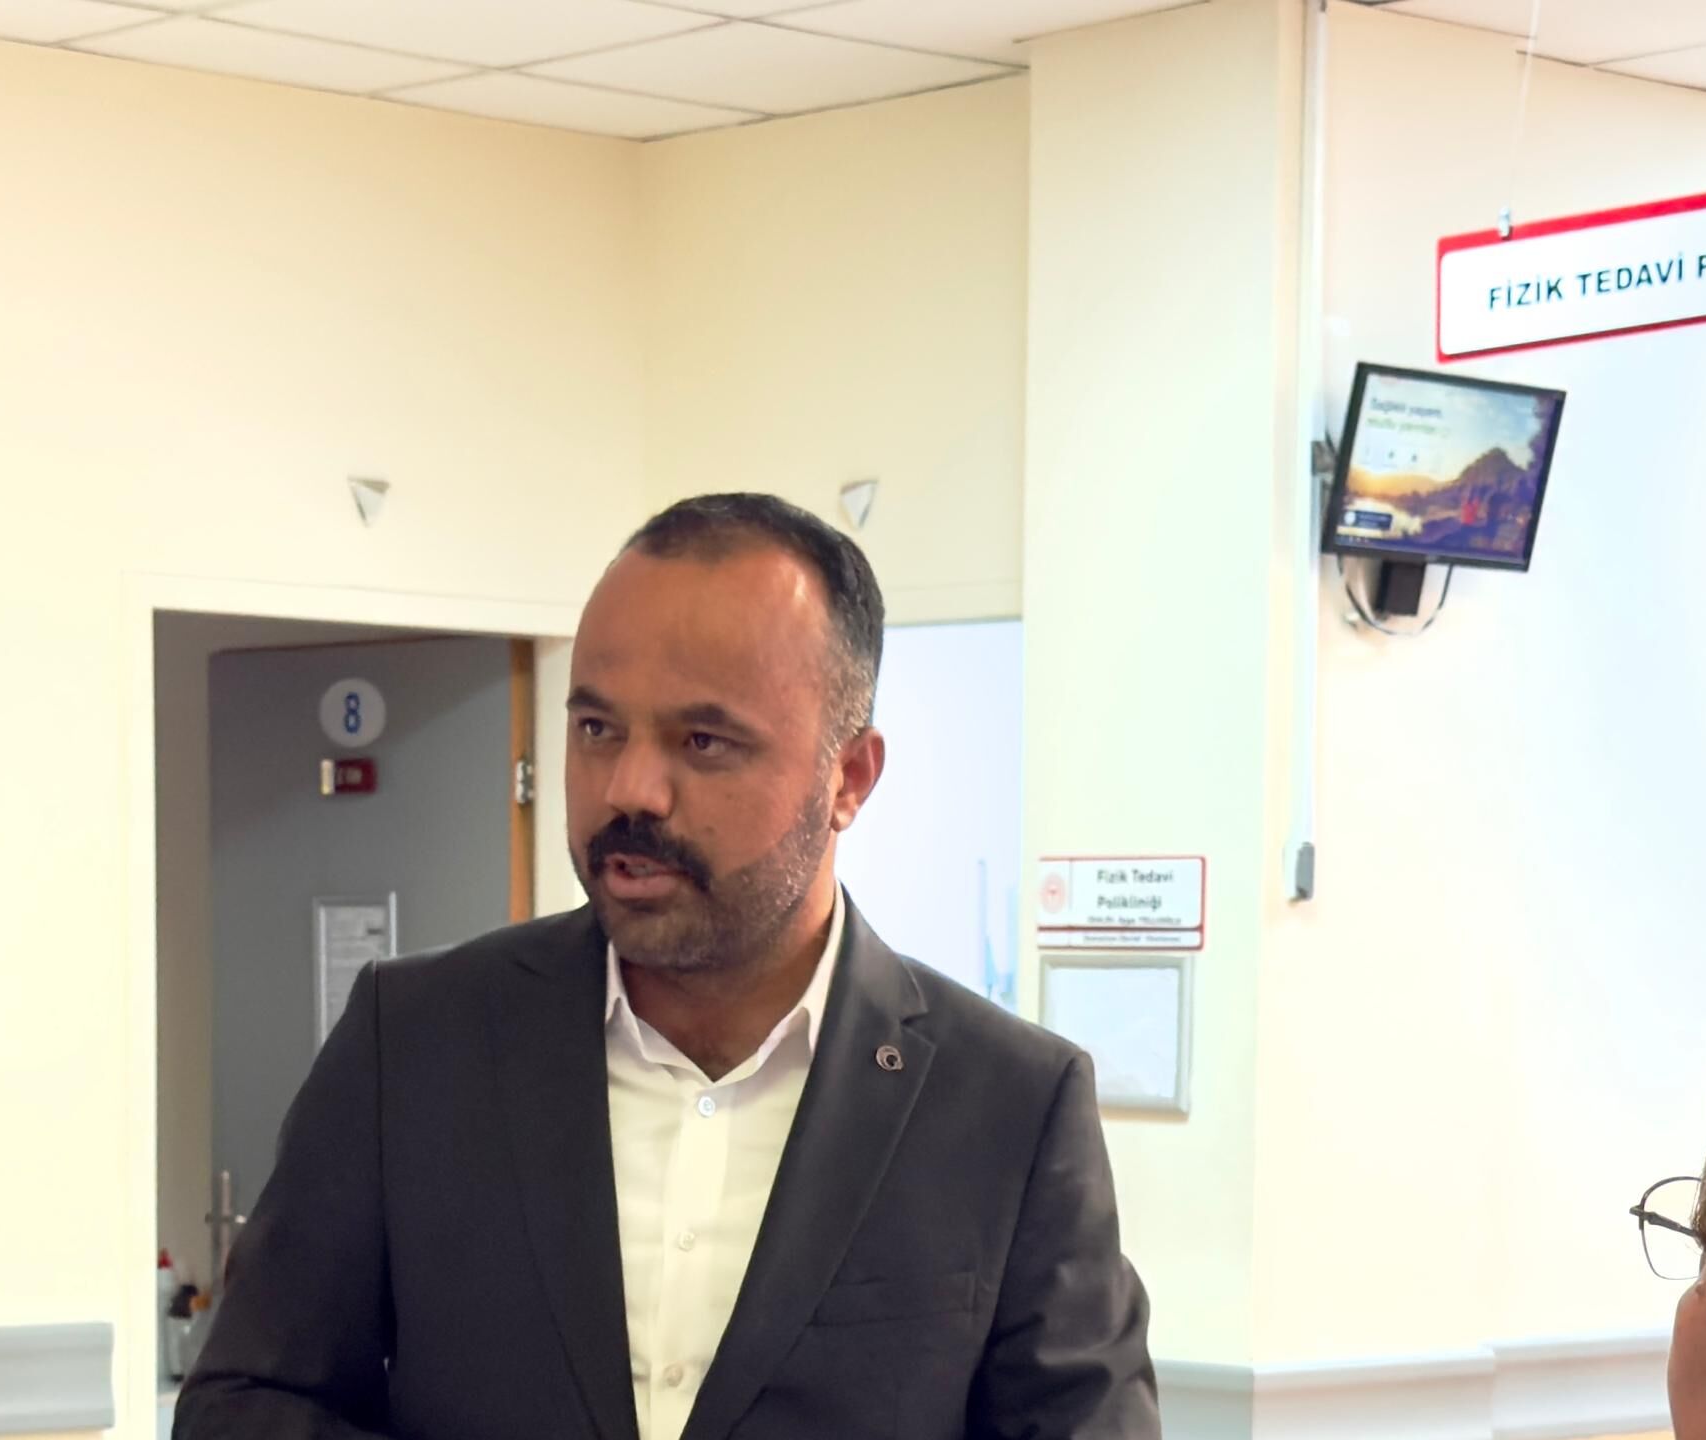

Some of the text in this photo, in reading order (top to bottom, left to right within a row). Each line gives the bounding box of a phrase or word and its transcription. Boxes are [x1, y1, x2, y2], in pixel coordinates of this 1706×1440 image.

[1488, 275, 1563, 310] FİZİK
[1576, 252, 1684, 296] TEDAVİ
[343, 691, 361, 734] 8
[1131, 869, 1175, 884] Tedavi
